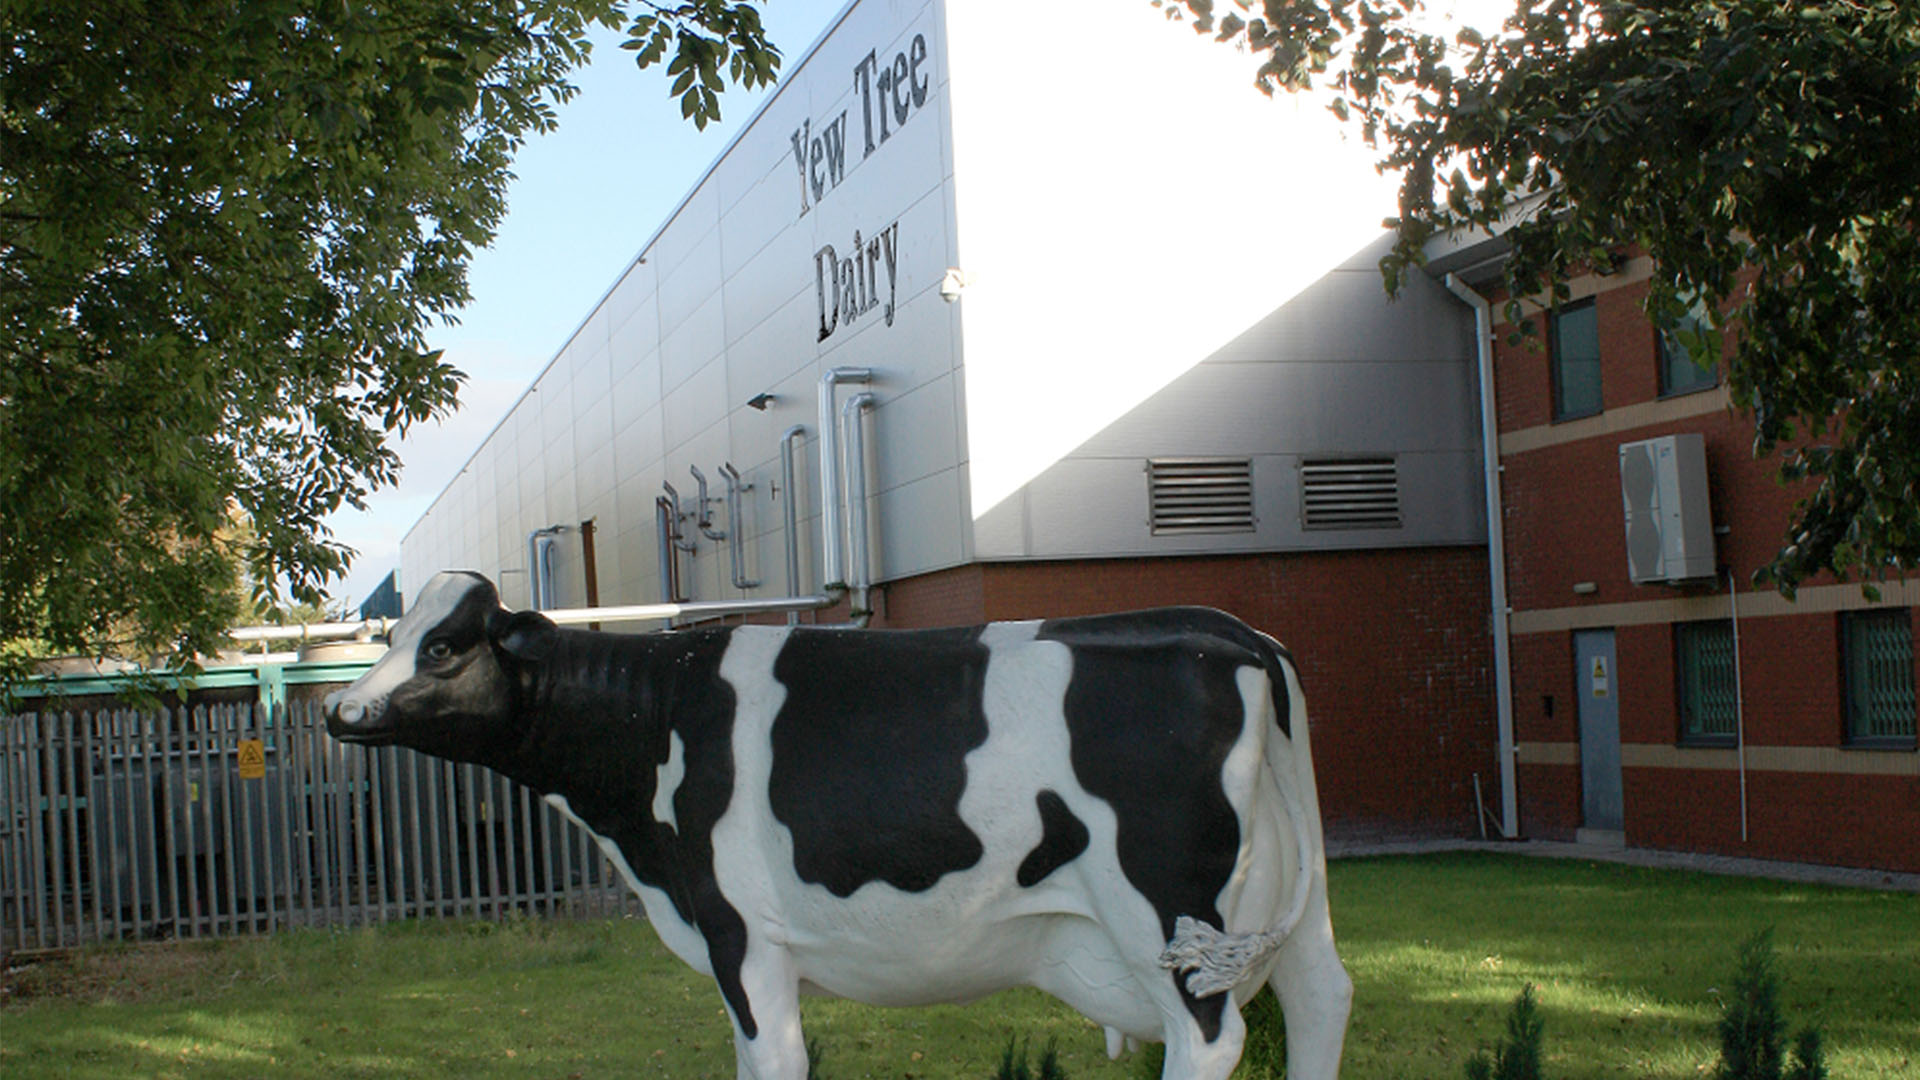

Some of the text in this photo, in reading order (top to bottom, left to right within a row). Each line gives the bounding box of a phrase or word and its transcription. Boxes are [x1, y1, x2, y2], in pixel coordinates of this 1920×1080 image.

[790, 33, 928, 218] Yew Tree
[813, 221, 898, 343] Dairy
